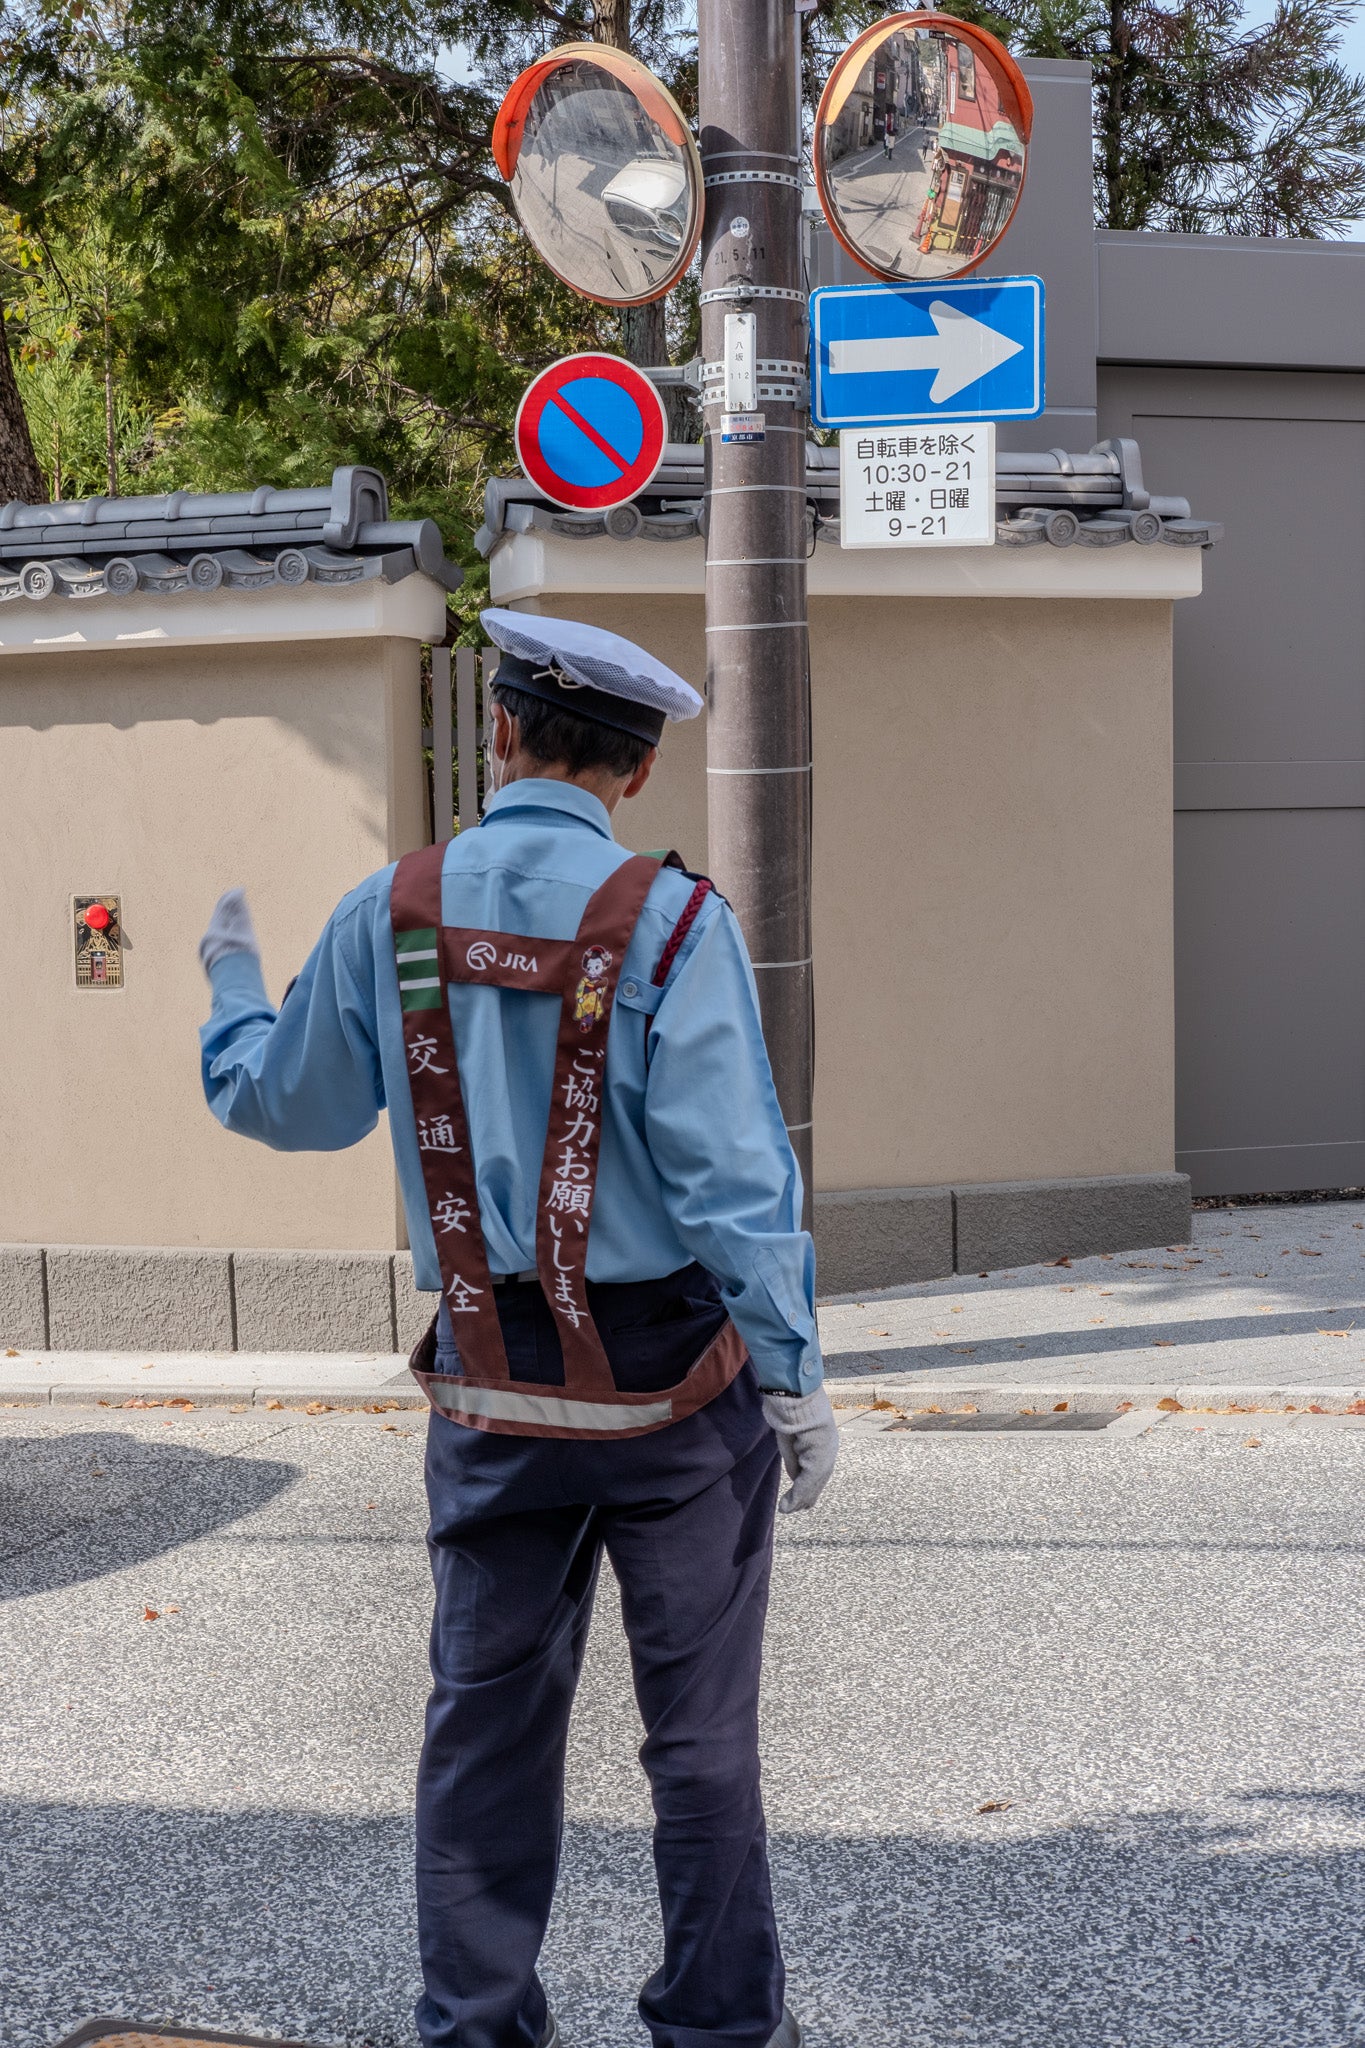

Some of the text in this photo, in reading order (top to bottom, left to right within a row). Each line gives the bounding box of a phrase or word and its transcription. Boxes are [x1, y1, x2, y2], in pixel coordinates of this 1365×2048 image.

[857, 434, 976, 459] 自転車を除く
[862, 461, 971, 485] 10:30-21
[865, 488, 970, 512] 土曜・日曜
[888, 516, 946, 537] 9-21
[499, 952, 538, 973] JRA
[408, 1034, 484, 1312] 交通安全
[545, 1047, 604, 1329] ご協力お願いします
